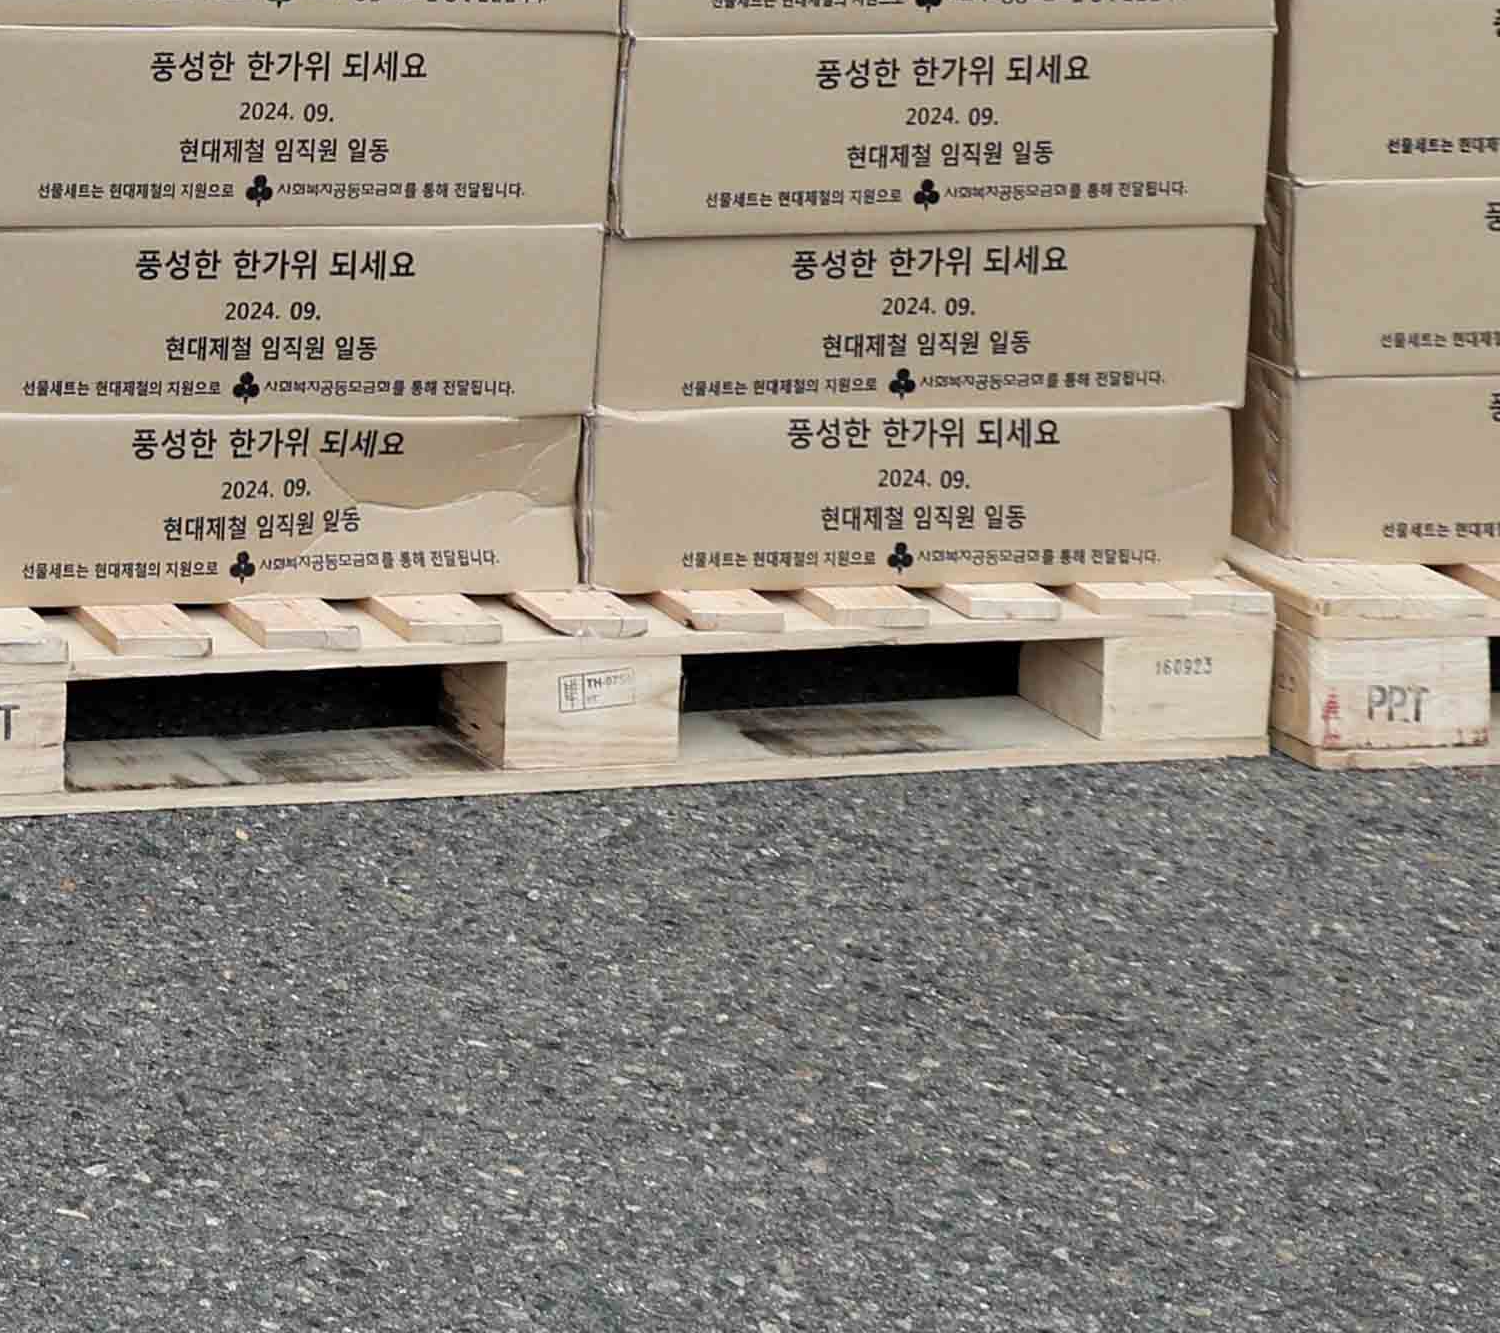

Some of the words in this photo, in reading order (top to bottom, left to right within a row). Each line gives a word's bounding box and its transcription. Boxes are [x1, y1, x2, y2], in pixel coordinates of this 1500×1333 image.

[790, 247, 878, 281] 풍성한
[888, 245, 972, 278] 한가위
[982, 244, 1069, 277] 되세요
[880, 296, 937, 317] 2024.
[944, 296, 976, 317] 09.
[821, 332, 908, 359] 현대제철
[916, 330, 980, 357] 임직원
[989, 329, 1032, 356] 일동
[680, 380, 749, 398] 선물세트는
[752, 378, 820, 396] 현대제철의
[824, 377, 877, 394] 지원으로
[1062, 372, 1091, 389] 통해
[1094, 370, 1165, 388] 전달됩니다.
[1366, 685, 1430, 723] PPT
